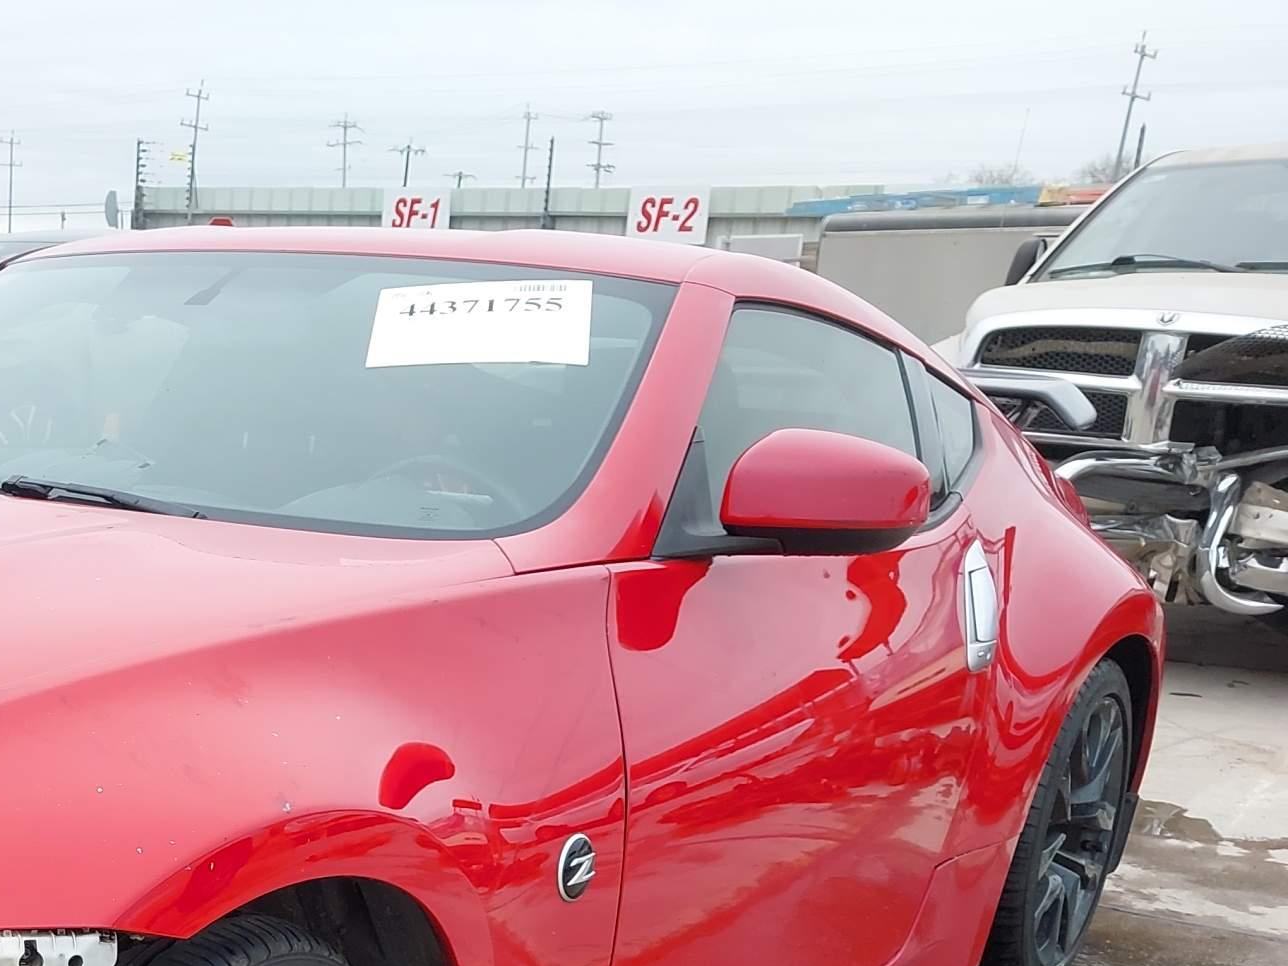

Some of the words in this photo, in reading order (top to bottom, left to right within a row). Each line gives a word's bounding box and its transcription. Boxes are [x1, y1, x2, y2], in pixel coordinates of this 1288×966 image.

[392, 198, 441, 227] SF-1
[636, 197, 700, 232] SF-2
[399, 298, 563, 317] 44371755
